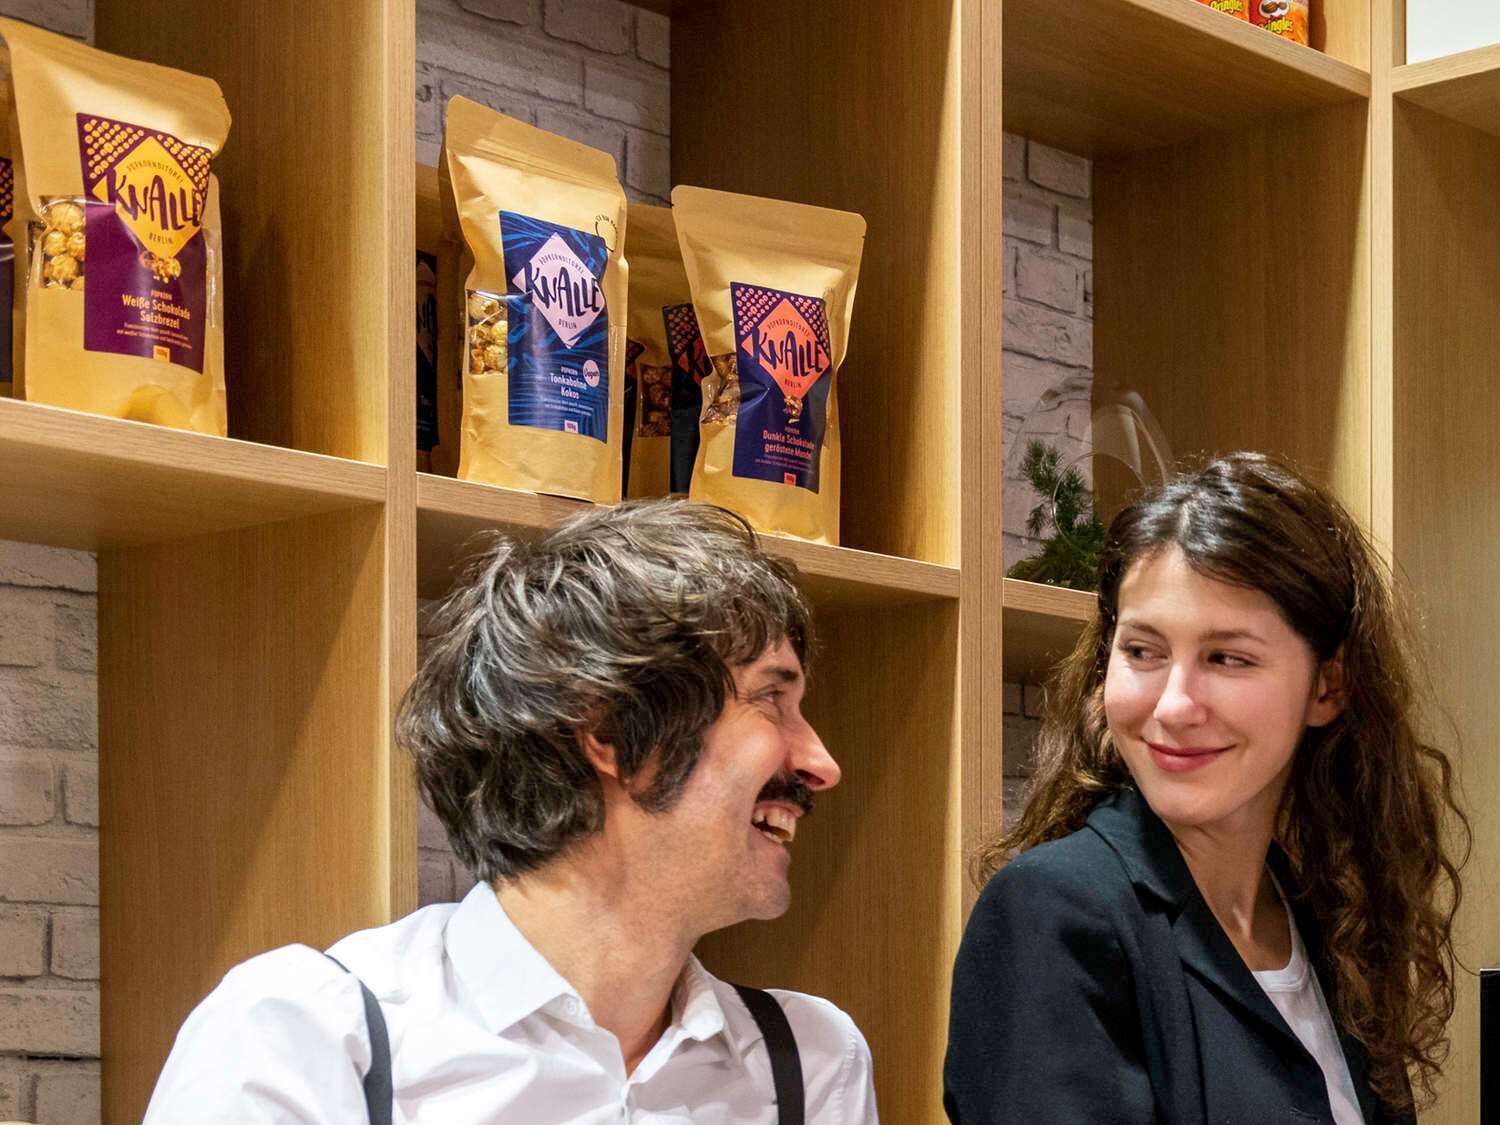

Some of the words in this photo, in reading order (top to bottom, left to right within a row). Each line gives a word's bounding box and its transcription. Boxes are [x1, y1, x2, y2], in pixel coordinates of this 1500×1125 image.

[121, 294, 151, 309] Weiße
[523, 262, 602, 318] KNALLE
[751, 325, 824, 378] KNALLE
[560, 386, 580, 400] Kokos
